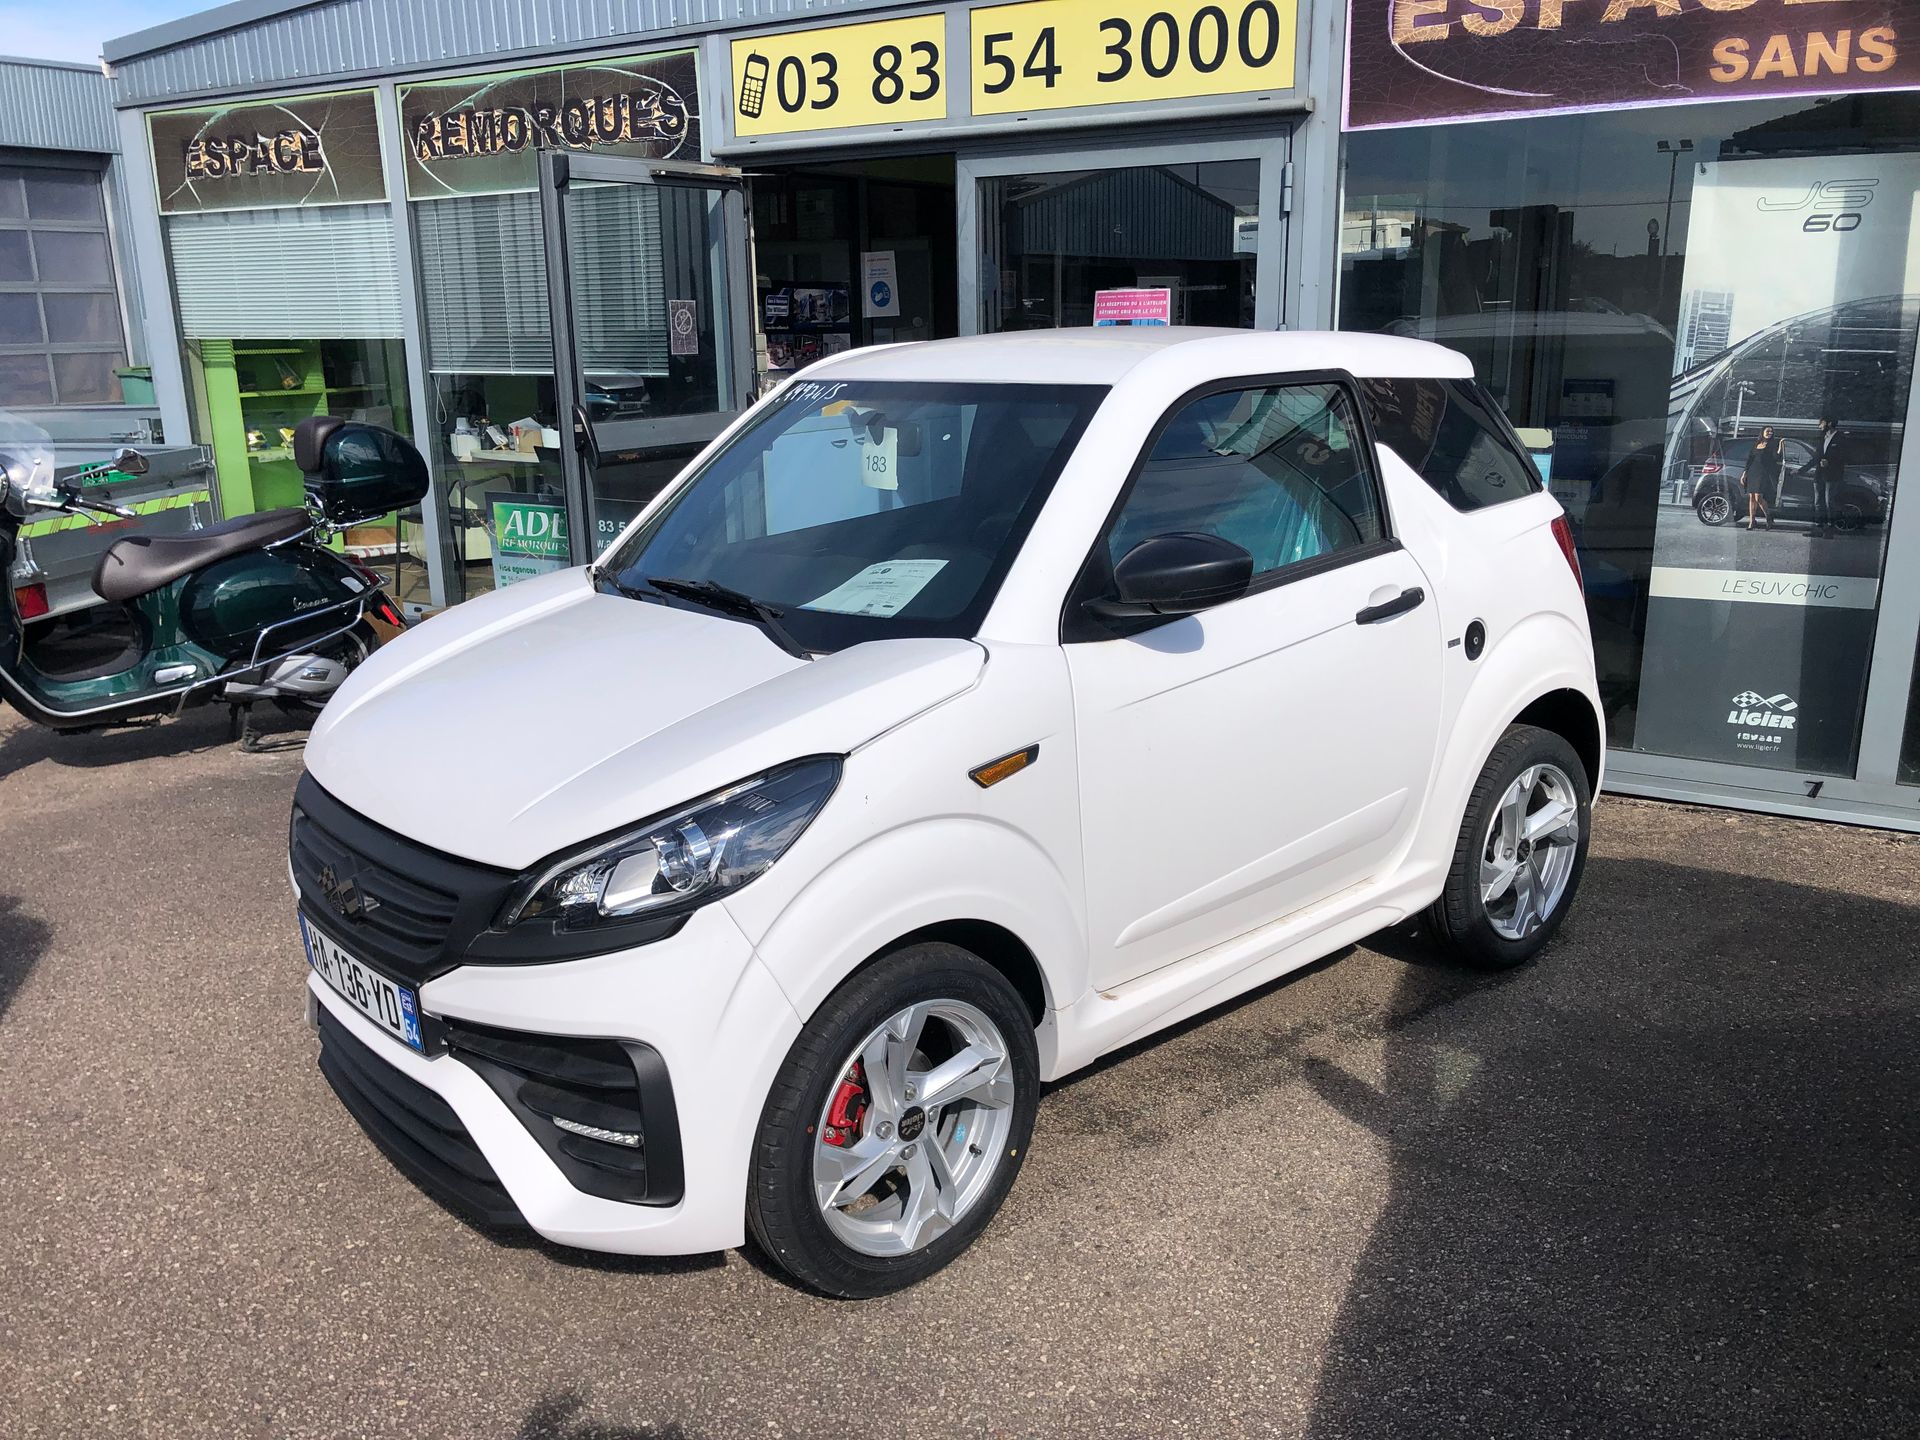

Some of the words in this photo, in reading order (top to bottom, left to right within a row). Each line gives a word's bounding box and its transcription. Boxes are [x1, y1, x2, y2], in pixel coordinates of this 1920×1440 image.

[777, 52, 839, 113] 03
[872, 41, 940, 104] 83
[984, 27, 1062, 94] 54
[1097, 0, 1280, 83] 3000
[1709, 27, 1898, 83] SANS
[413, 92, 688, 160] REMORQUES
[185, 130, 324, 178] ESPACE
[1757, 179, 1880, 211] JS
[1803, 213, 1862, 232] 60
[865, 454, 887, 473] 183
[504, 510, 567, 539] ADL
[598, 520, 615, 533] 83
[1722, 579, 1747, 594] LE
[1748, 580, 1790, 596] SUV
[1791, 583, 1839, 599] CHIC
[1736, 742, 1780, 752] www.ligier.fr
[404, 1018, 420, 1045] 54
